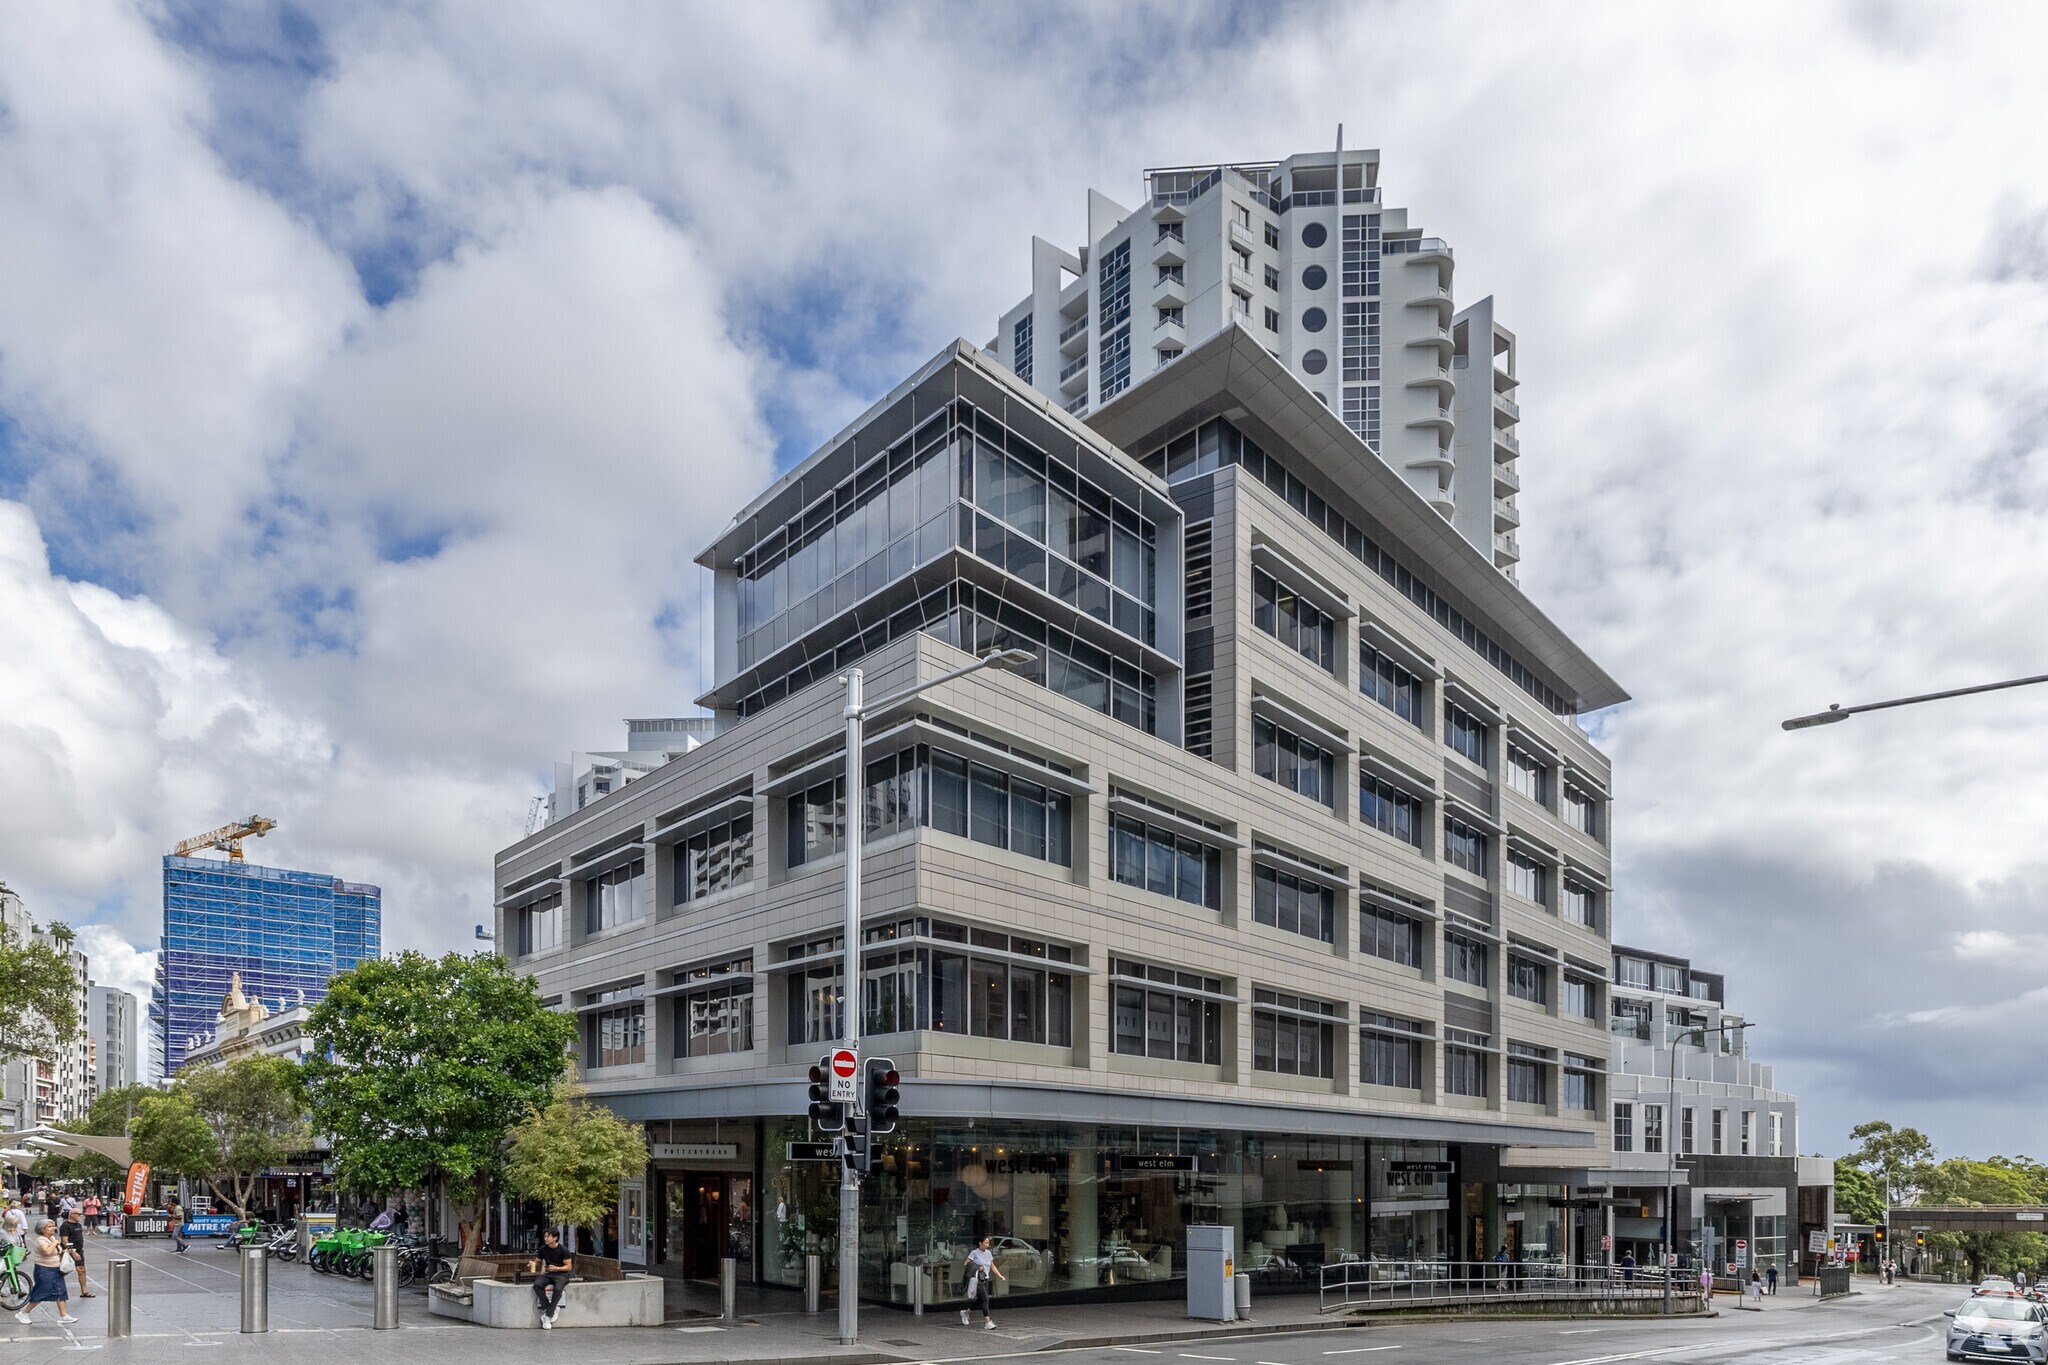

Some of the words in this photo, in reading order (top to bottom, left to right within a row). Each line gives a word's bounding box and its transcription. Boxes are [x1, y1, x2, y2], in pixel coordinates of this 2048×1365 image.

[832, 1090, 855, 1098] ENTRY
[815, 1148, 834, 1156] wes
[985, 1157, 1023, 1174] west
[1138, 1159, 1156, 1167] west
[1159, 1159, 1174, 1167] elm
[1386, 1171, 1411, 1186] west
[131, 1169, 145, 1204] STIHL
[135, 1218, 167, 1232] weber
